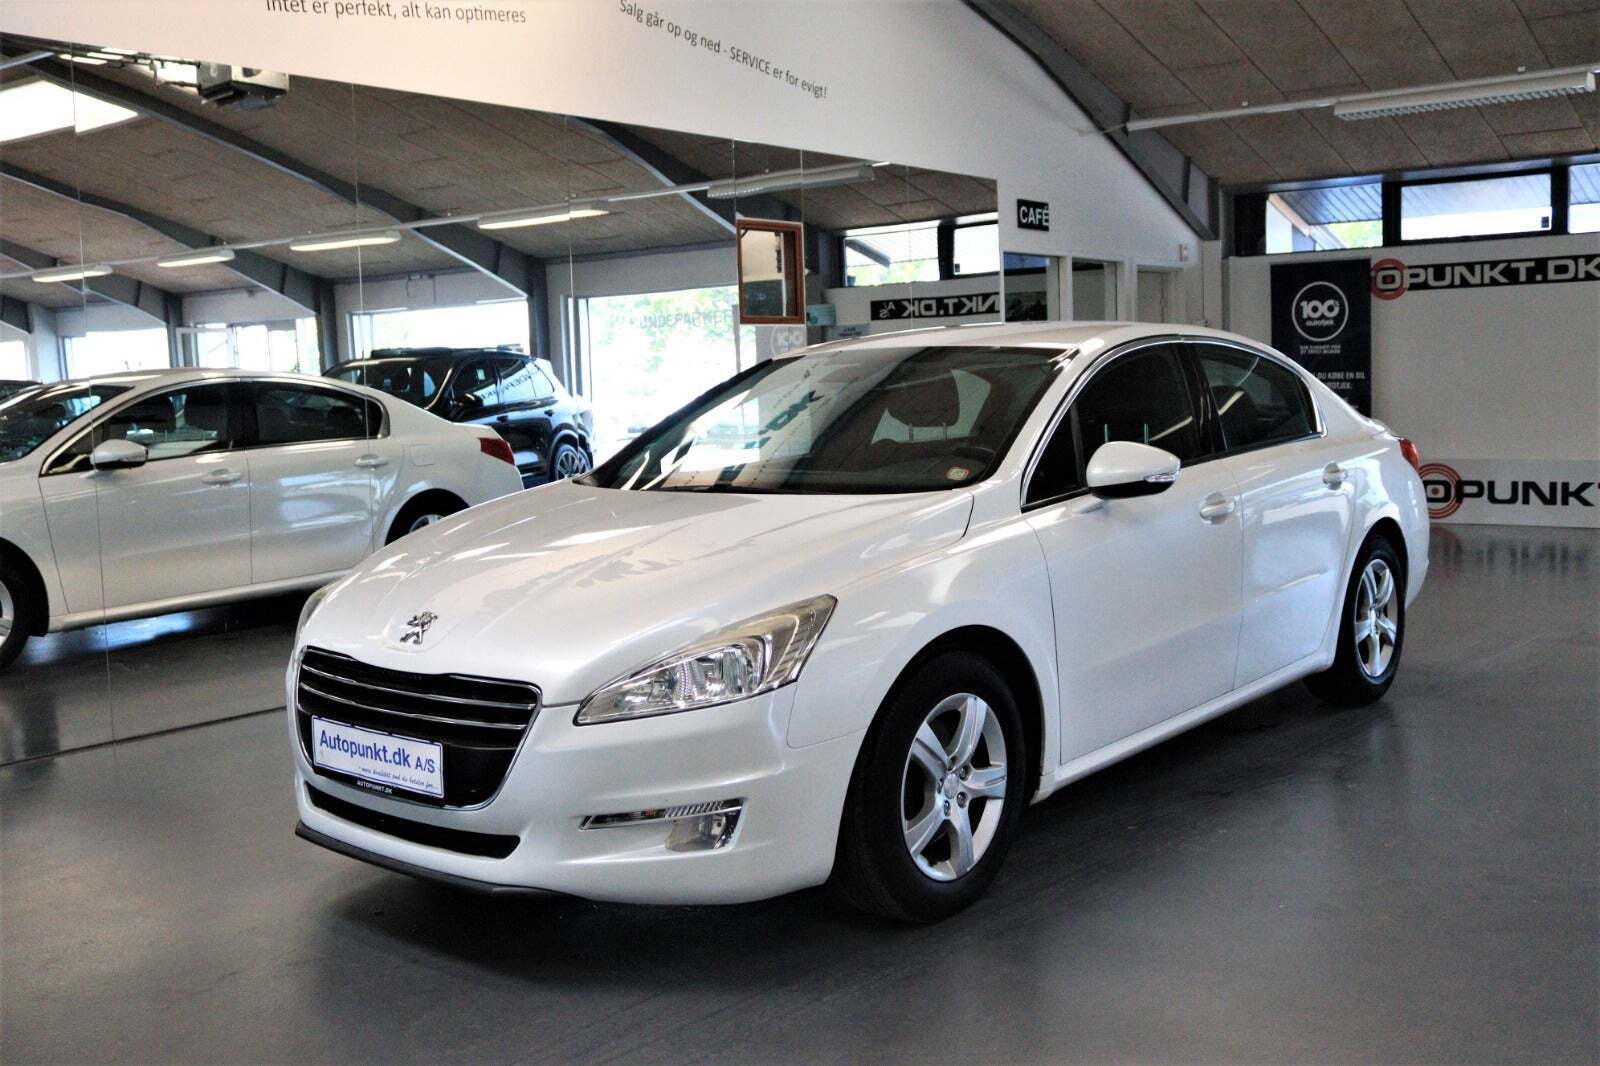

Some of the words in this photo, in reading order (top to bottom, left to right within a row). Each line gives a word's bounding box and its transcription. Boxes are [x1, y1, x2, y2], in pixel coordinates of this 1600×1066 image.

[266, 0, 307, 13] Intet
[312, 1, 329, 14] er
[335, 0, 397, 20] perfekt,
[401, 1, 421, 18] alt
[425, 1, 451, 19] kan
[455, 5, 526, 24] optimeres
[619, 0, 643, 23] Salg
[646, 11, 664, 28] går
[667, 22, 681, 38] op
[684, 30, 697, 46] og
[700, 36, 720, 53] ned
[730, 46, 770, 75] SERVICE
[773, 67, 783, 80] er
[785, 69, 798, 87] for
[801, 79, 827, 99] evigt!
[1020, 205, 1049, 226] CAFÉ
[1376, 257, 1600, 290] OPUNKT.DK
[1423, 479, 1600, 507] OPUNK
[320, 729, 412, 768] Autopunkt.dk
[415, 757, 435, 773] A/S
